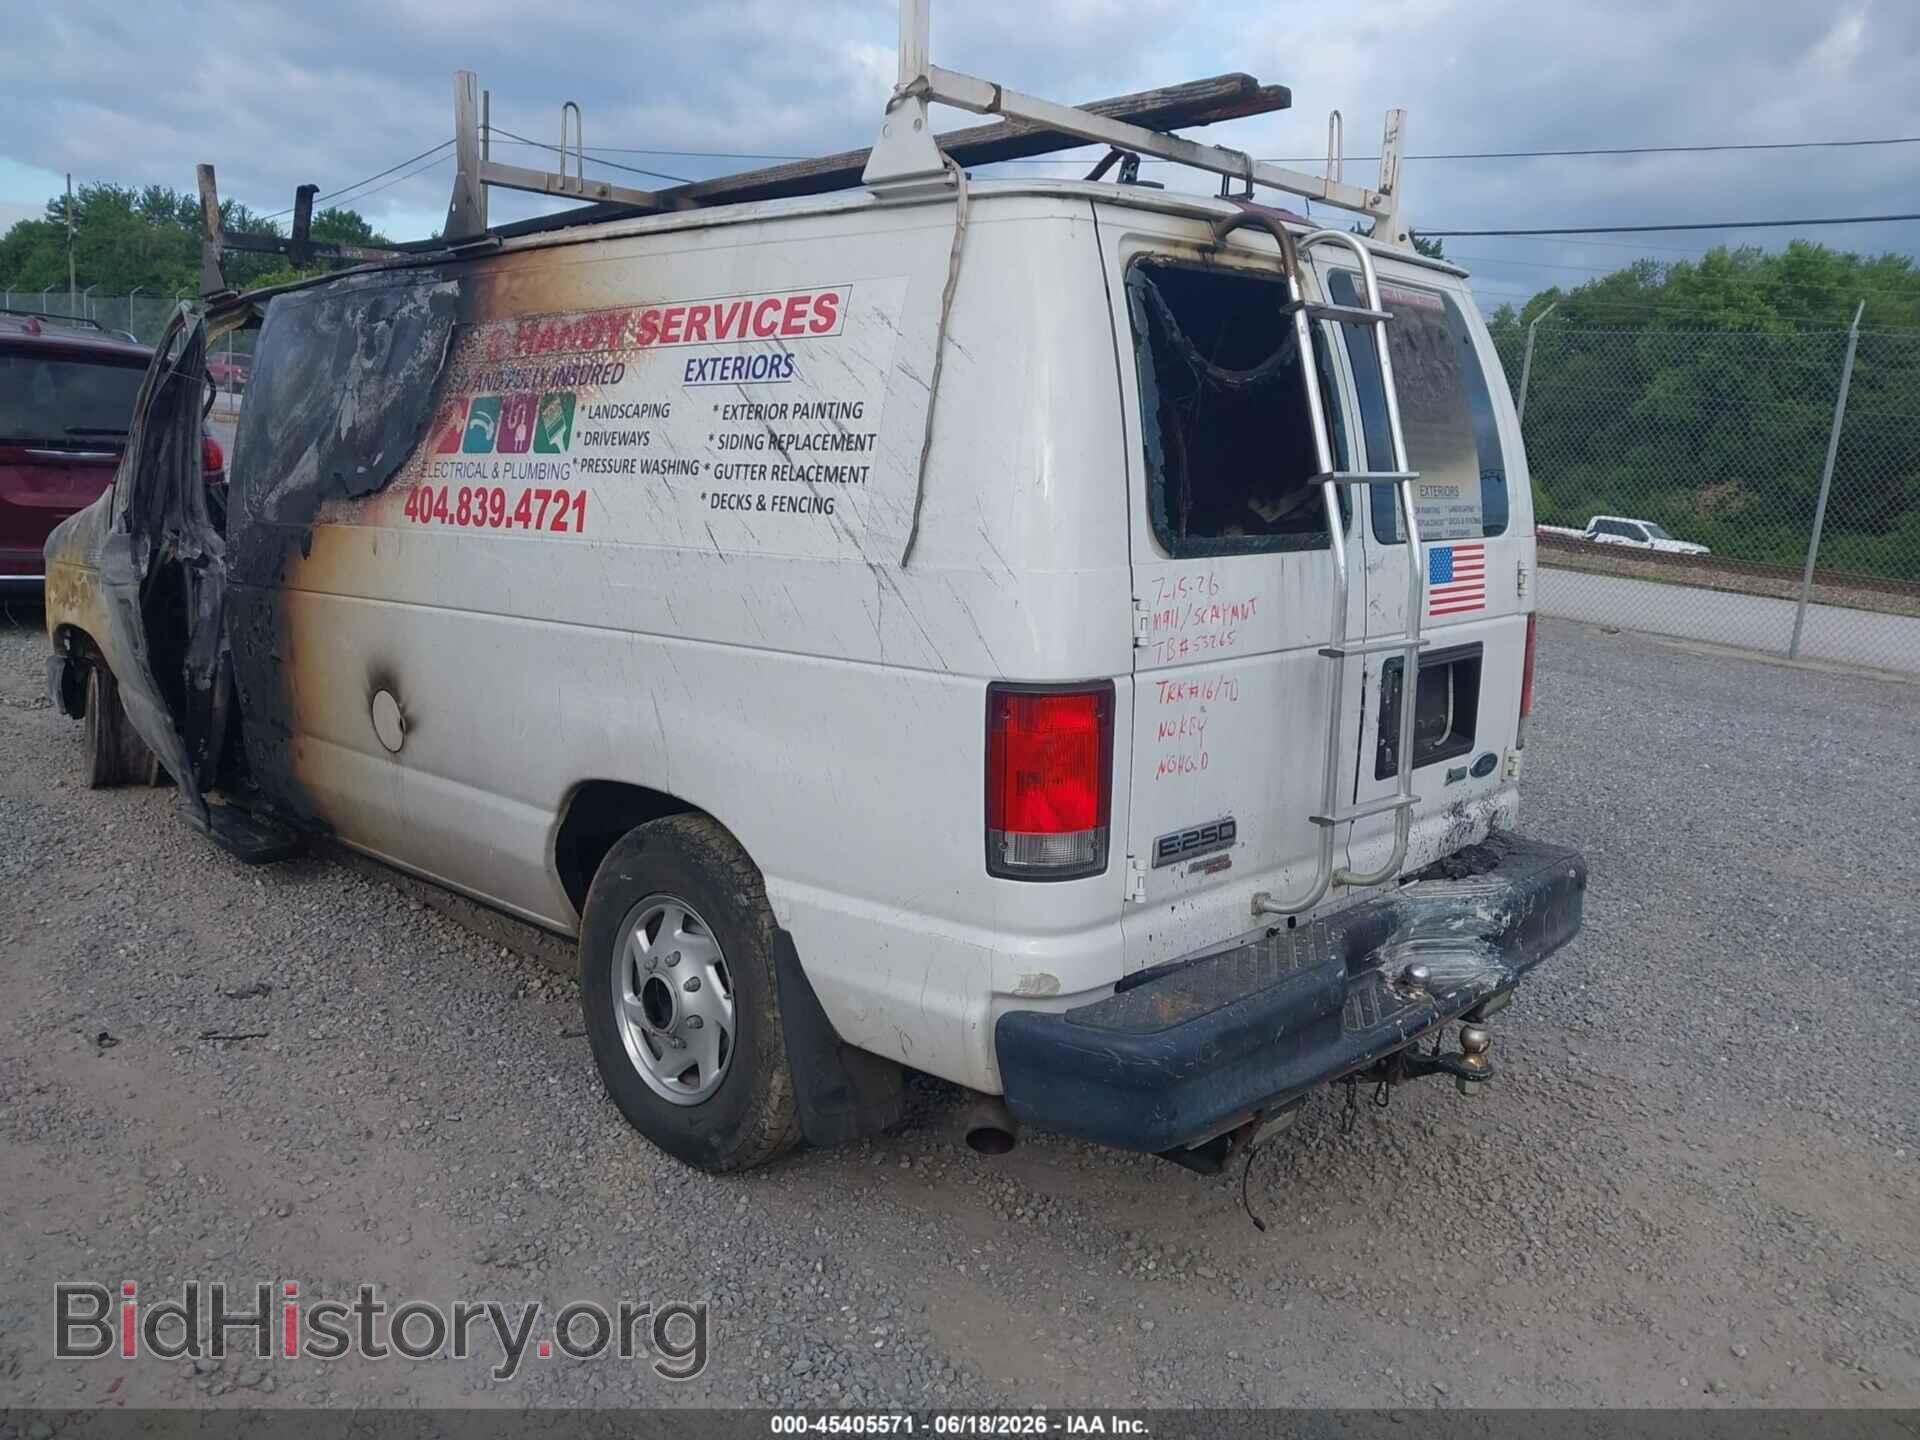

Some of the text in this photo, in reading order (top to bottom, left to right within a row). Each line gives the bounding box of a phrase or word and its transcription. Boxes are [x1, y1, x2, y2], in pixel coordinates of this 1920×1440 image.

[636, 292, 840, 346] SERVICES
[551, 362, 626, 387] INSURED
[683, 353, 795, 383] EXTERIORS
[588, 402, 671, 420] LANDSCAPING
[721, 401, 864, 421] EXTERIOR PAINTING
[583, 430, 650, 448] DRIVEWAYS
[717, 433, 876, 452] SIDING REPLACEMENT
[421, 461, 570, 480] ELECTRICAL & PLUMBING
[580, 458, 700, 476] PRESSURE WASHING
[714, 463, 870, 484] GUTTER RELACEMENT
[404, 485, 588, 533] 404.839.4721
[710, 492, 834, 515] DECKS & FENCING
